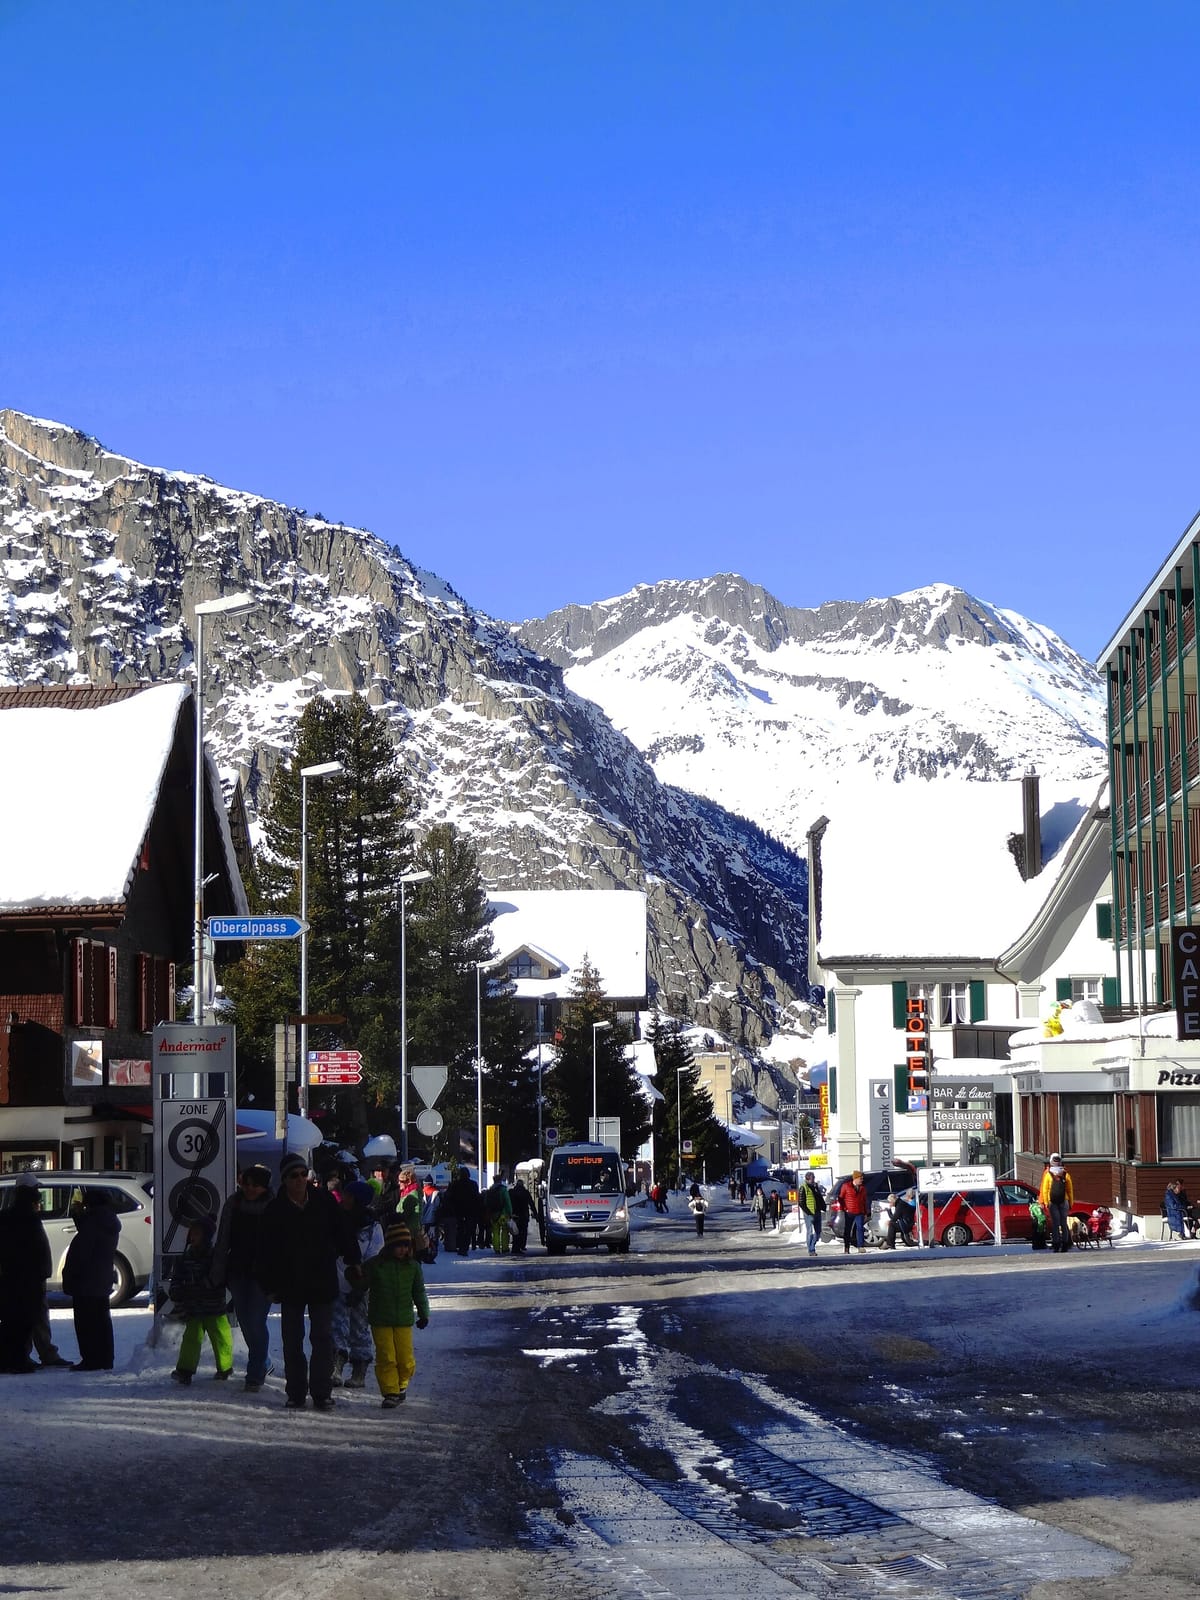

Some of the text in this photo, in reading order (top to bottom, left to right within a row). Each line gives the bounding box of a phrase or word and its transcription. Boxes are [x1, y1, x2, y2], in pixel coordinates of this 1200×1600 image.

[213, 921, 287, 936] Oberalppass
[1178, 932, 1200, 1034] CAFE
[159, 1037, 221, 1051] Andermatt
[908, 1000, 924, 1090] HOTEL
[933, 1087, 953, 1097] BAR
[908, 1096, 919, 1109] P
[180, 1104, 208, 1115] ZONE
[933, 1111, 993, 1120] Restaurant
[934, 1121, 982, 1130] Terrasse
[879, 1103, 890, 1168] ntonalbank
[183, 1134, 204, 1153] 30
[564, 1198, 610, 1206] Dorfbus
